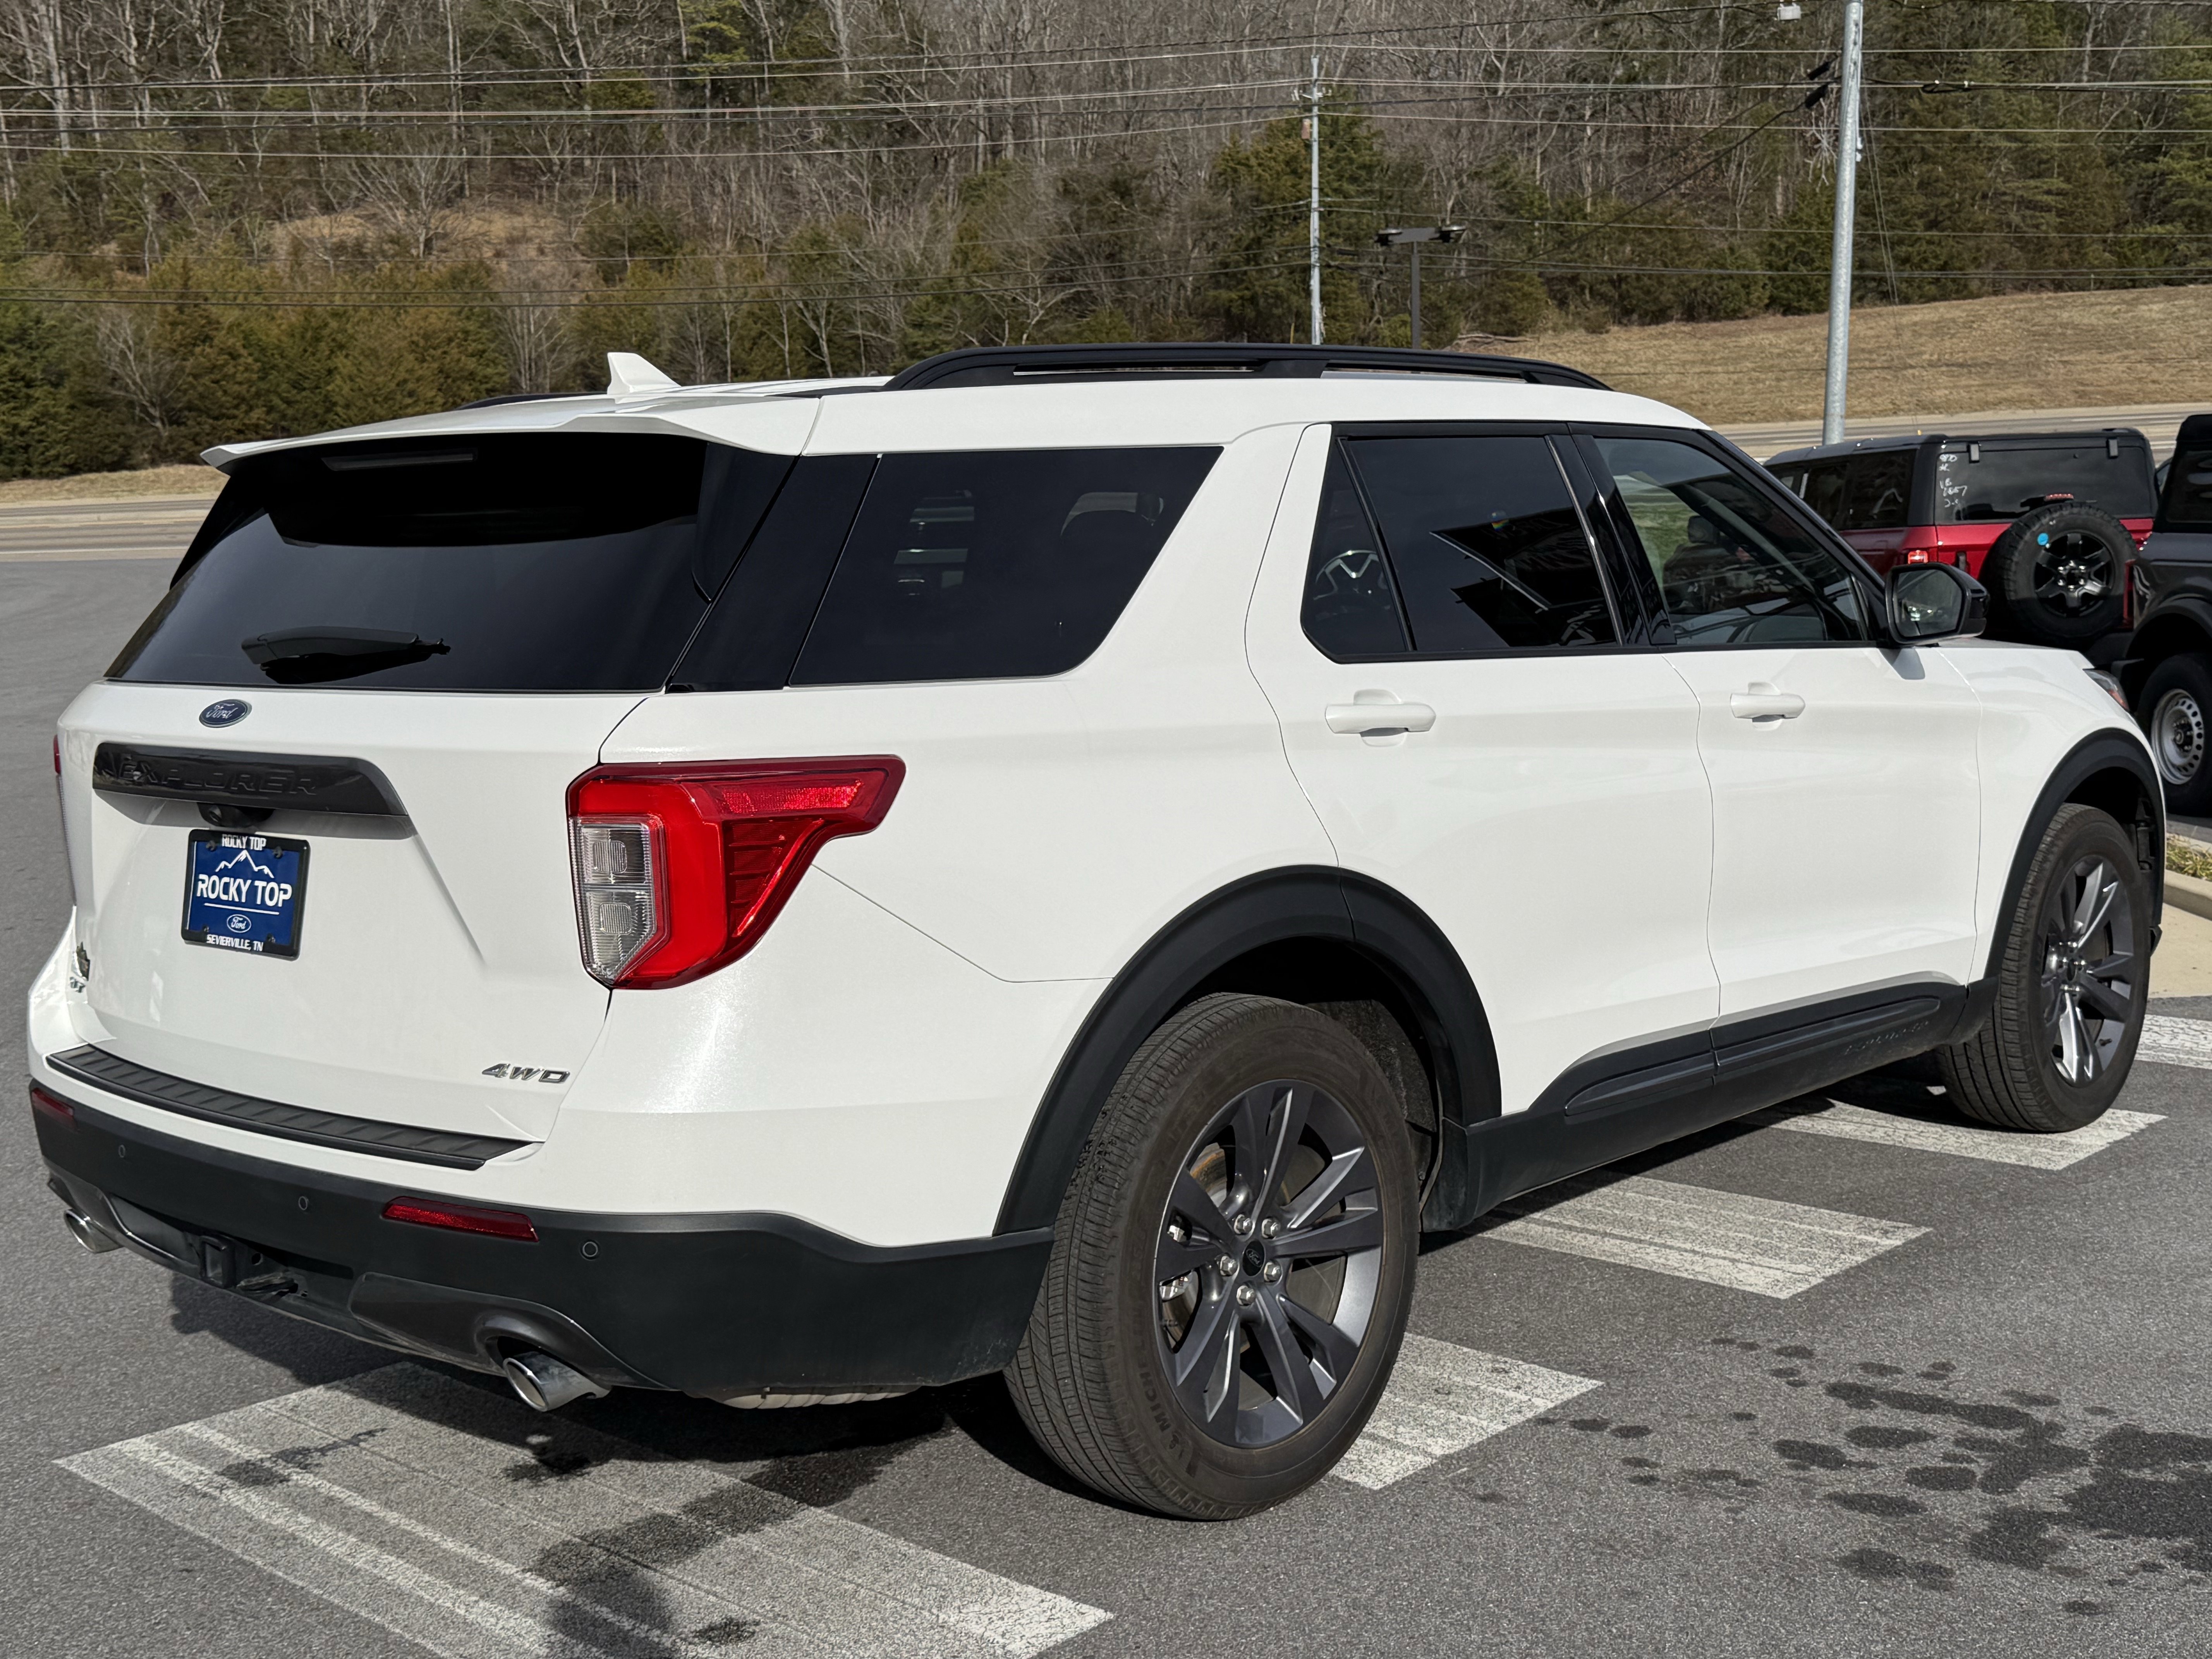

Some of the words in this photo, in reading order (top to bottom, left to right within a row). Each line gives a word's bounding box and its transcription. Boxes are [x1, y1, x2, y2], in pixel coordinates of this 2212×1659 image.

[119, 760, 317, 795] EXPLORER
[222, 834, 248, 849] ROCKY
[249, 836, 266, 851] TOP
[196, 874, 252, 903] ROCKY
[254, 880, 292, 907] TOP
[206, 934, 251, 951] SEVIERVILLE,
[253, 940, 264, 952] TN
[482, 1063, 570, 1084] 4WD
